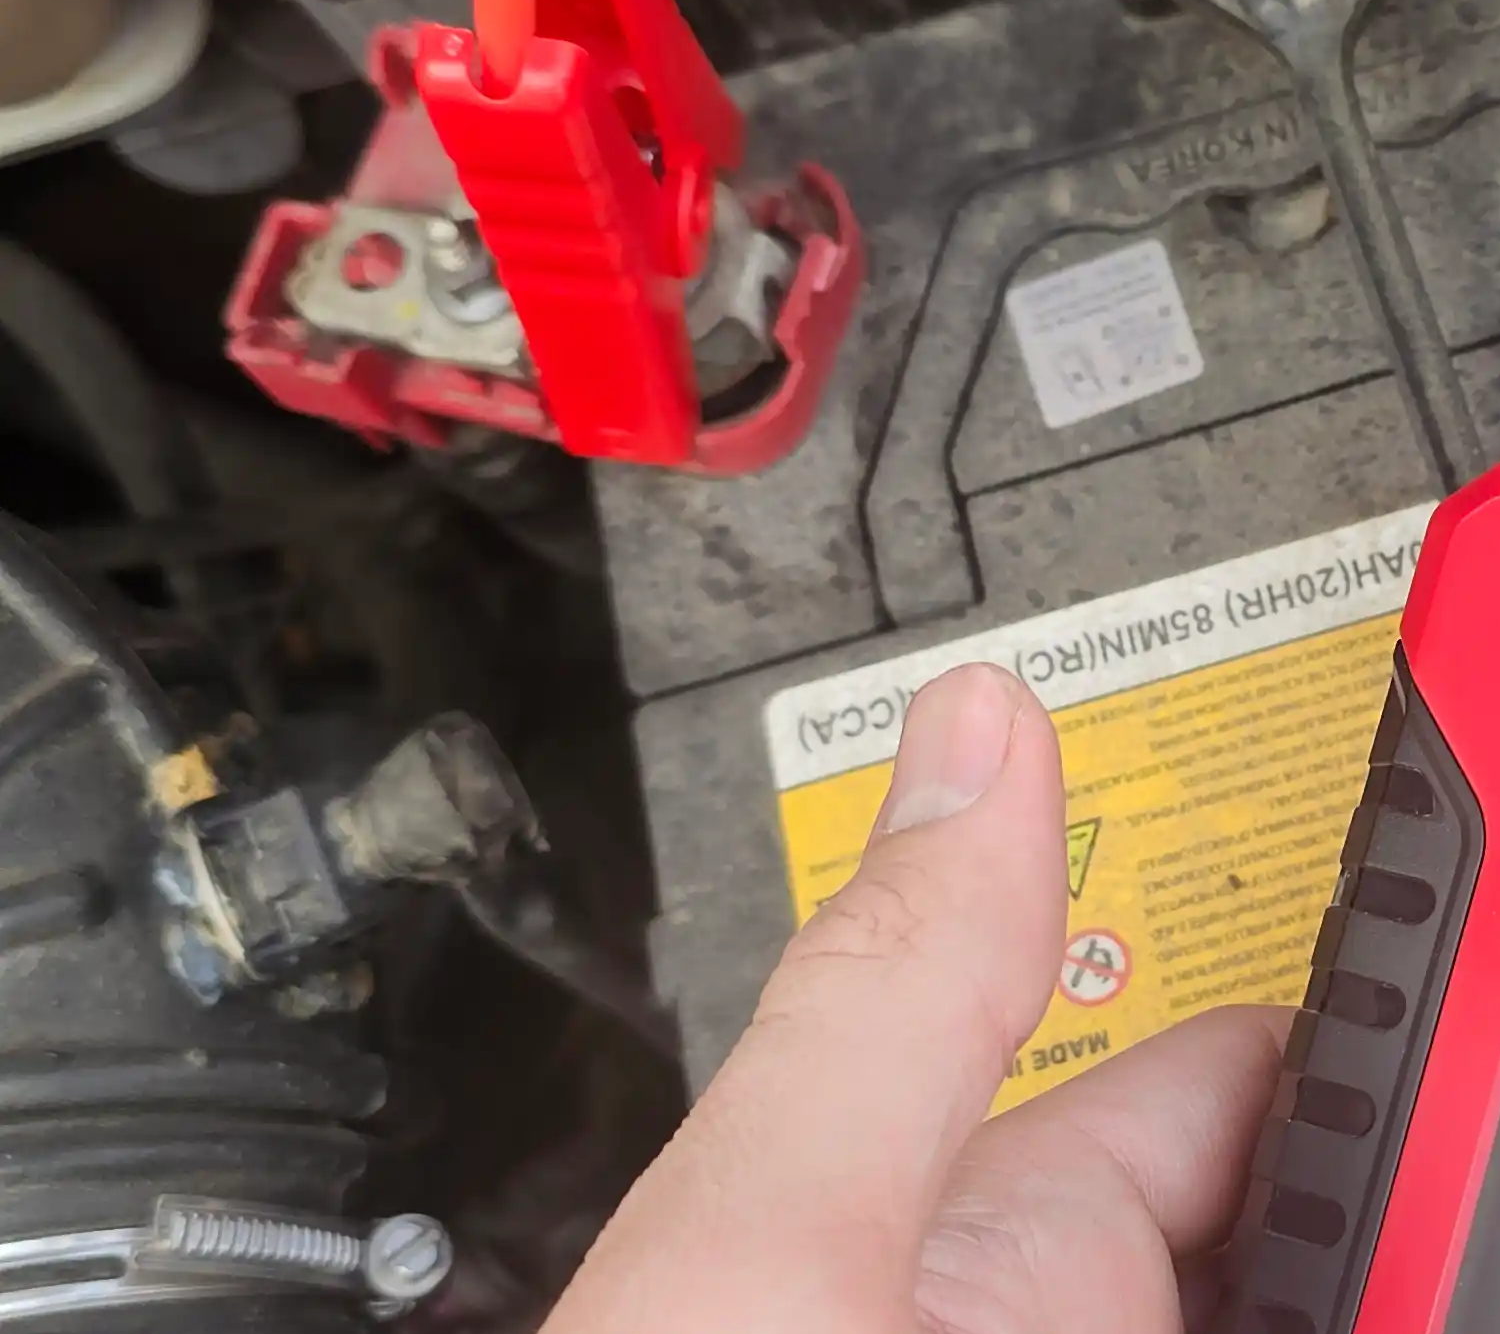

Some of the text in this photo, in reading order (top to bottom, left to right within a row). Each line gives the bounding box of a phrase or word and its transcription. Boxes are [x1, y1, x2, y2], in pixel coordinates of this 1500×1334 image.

[1015, 603, 1214, 683] 85MIN(RC)
[798, 686, 914, 754] (CCA)
[1031, 1028, 1110, 1072] MADE
